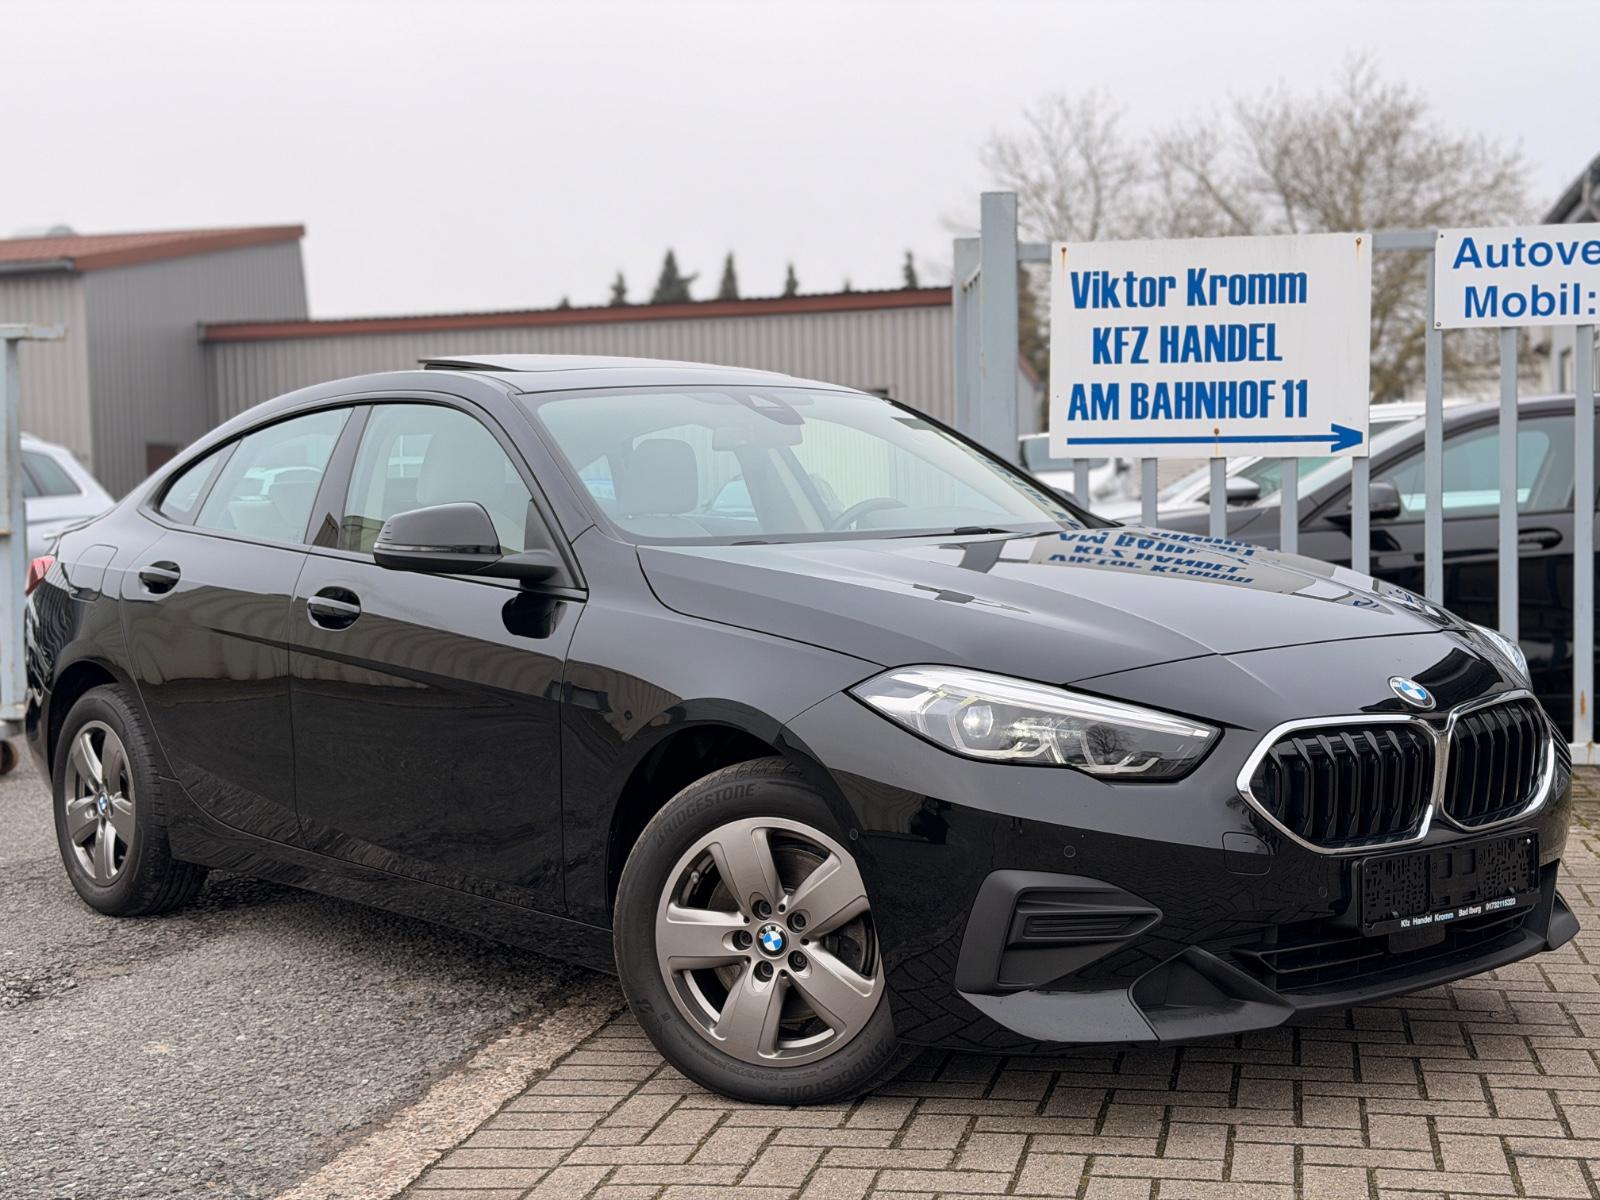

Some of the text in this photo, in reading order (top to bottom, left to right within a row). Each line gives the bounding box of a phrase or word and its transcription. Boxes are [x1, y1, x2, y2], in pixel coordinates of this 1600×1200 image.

[1071, 267, 1308, 310] Viktor Kromm
[1463, 282, 1597, 319] Mobil:
[1091, 322, 1283, 366] KFZ HANDEL
[1067, 379, 1309, 422] AM BAHNHOF 11
[1412, 914, 1433, 926] Handel
[1434, 911, 1455, 922] Kromm
